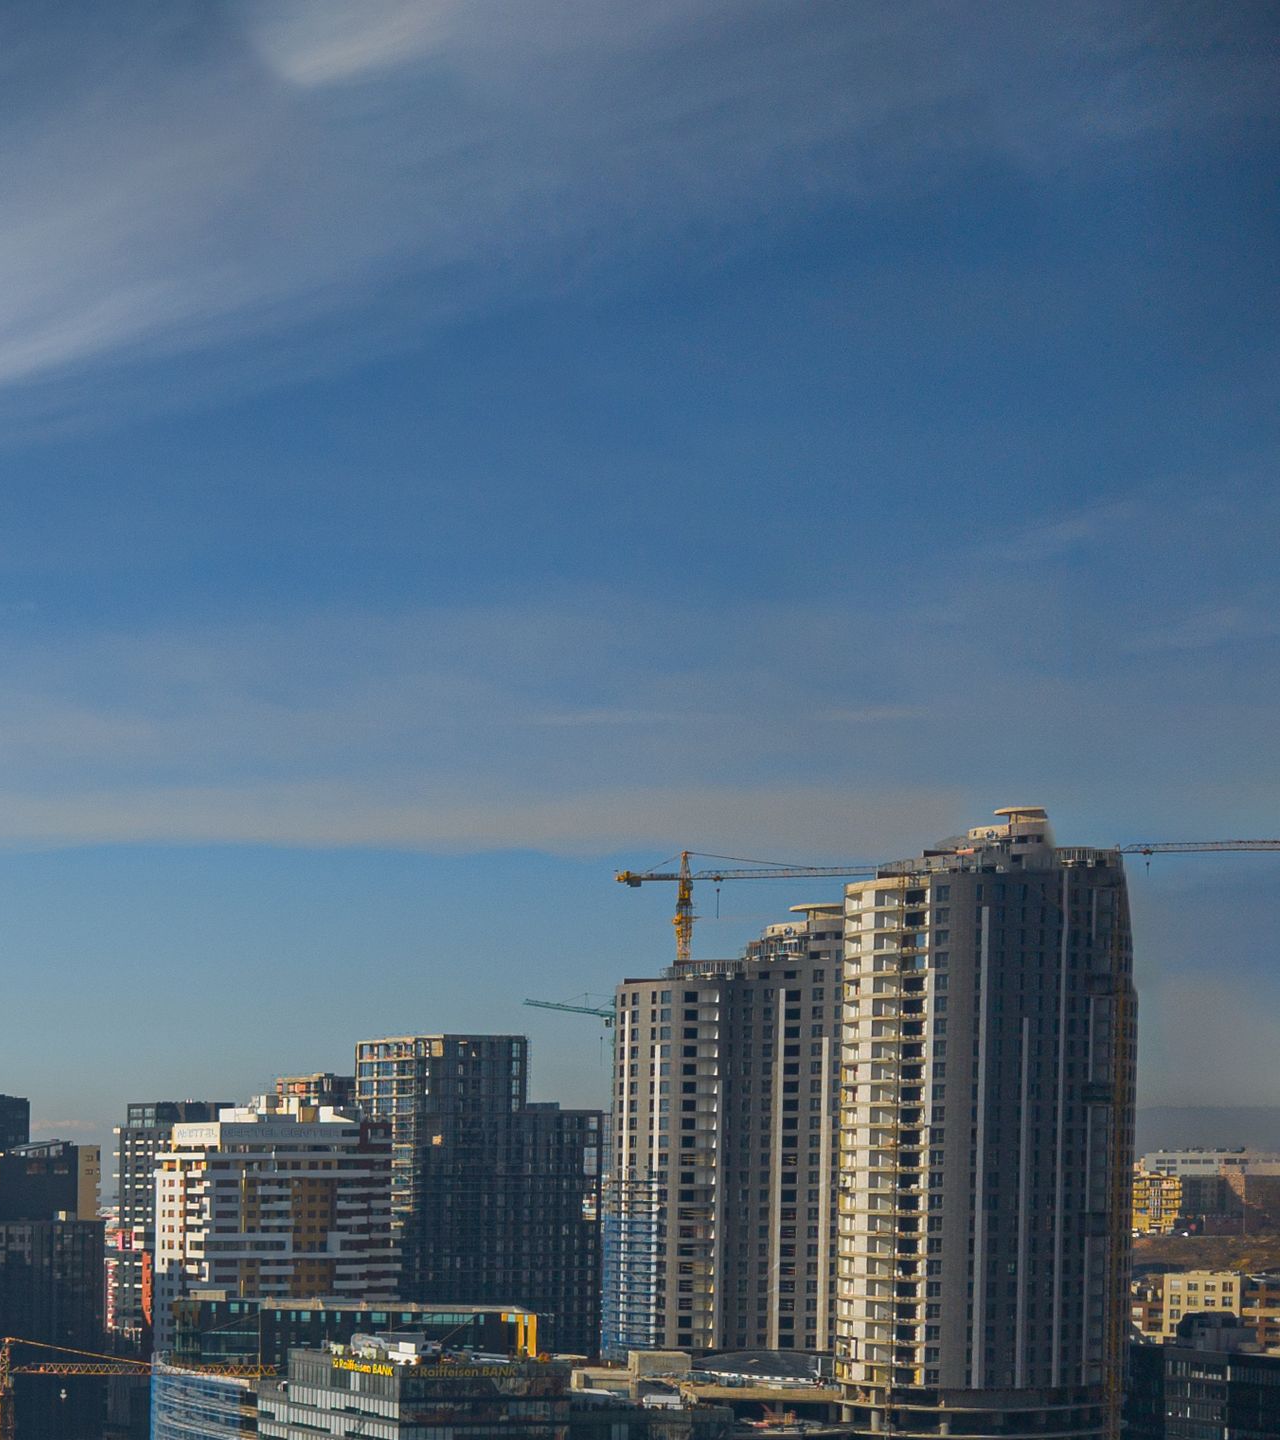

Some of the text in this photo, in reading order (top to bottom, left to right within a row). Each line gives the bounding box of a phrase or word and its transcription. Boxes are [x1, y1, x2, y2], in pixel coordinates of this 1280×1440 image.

[338, 1358, 394, 1377] Raiffeisen BANK
[419, 1366, 517, 1378] Raiffeisen BANK
